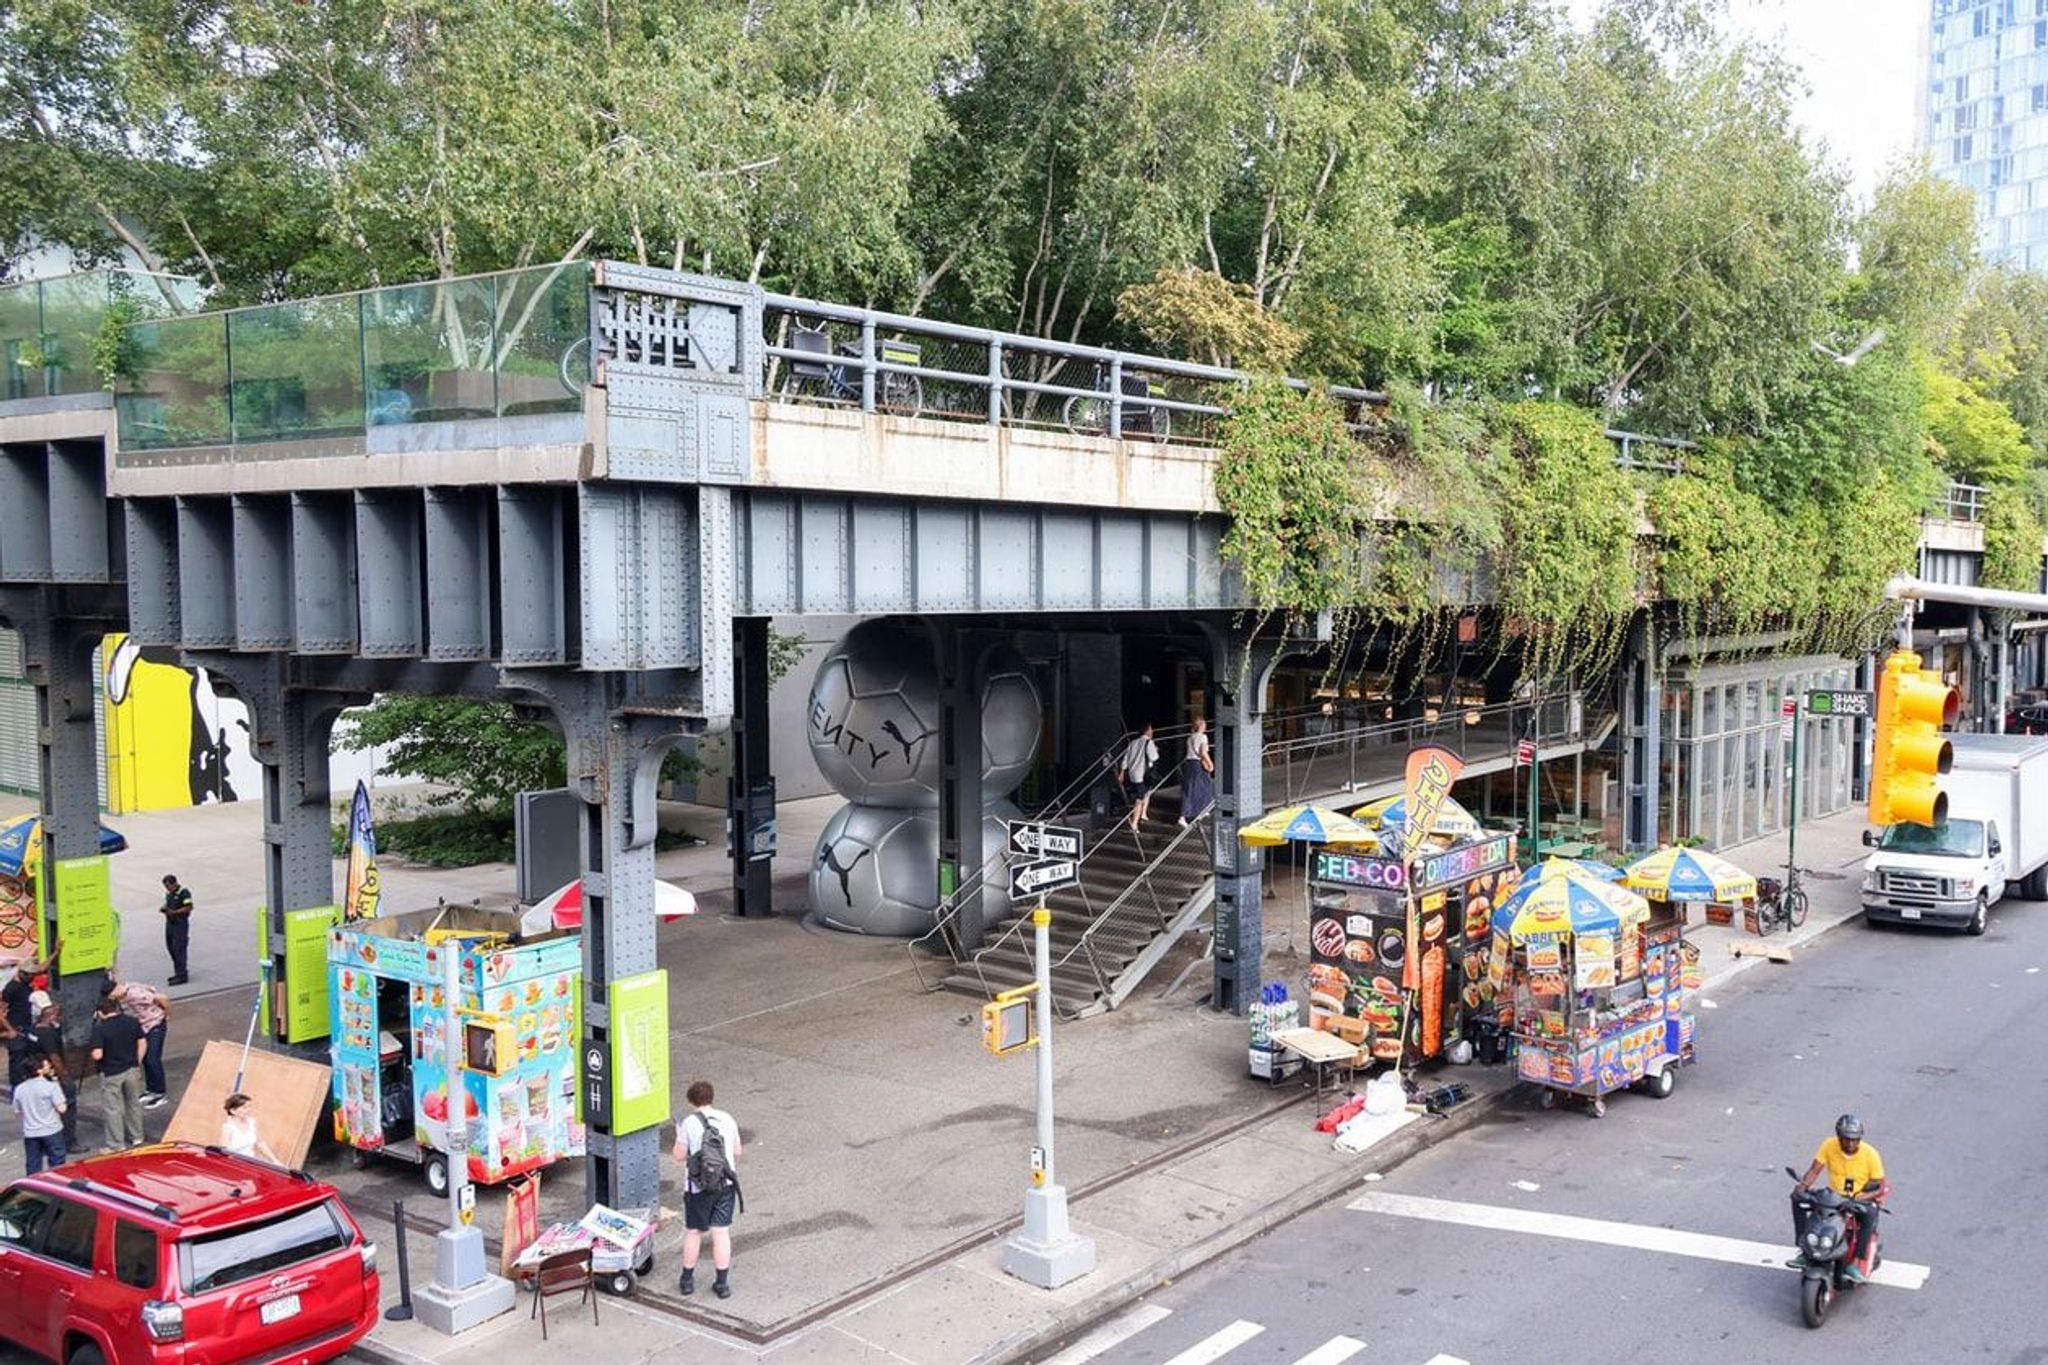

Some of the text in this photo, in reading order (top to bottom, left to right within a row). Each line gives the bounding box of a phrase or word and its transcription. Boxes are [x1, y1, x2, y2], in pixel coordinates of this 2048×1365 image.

[1831, 693, 1867, 703] SHAKE
[1831, 703, 1868, 714] SHACK
[1019, 831, 1072, 850] ONE WAY
[1021, 864, 1070, 887] ONE WAY
